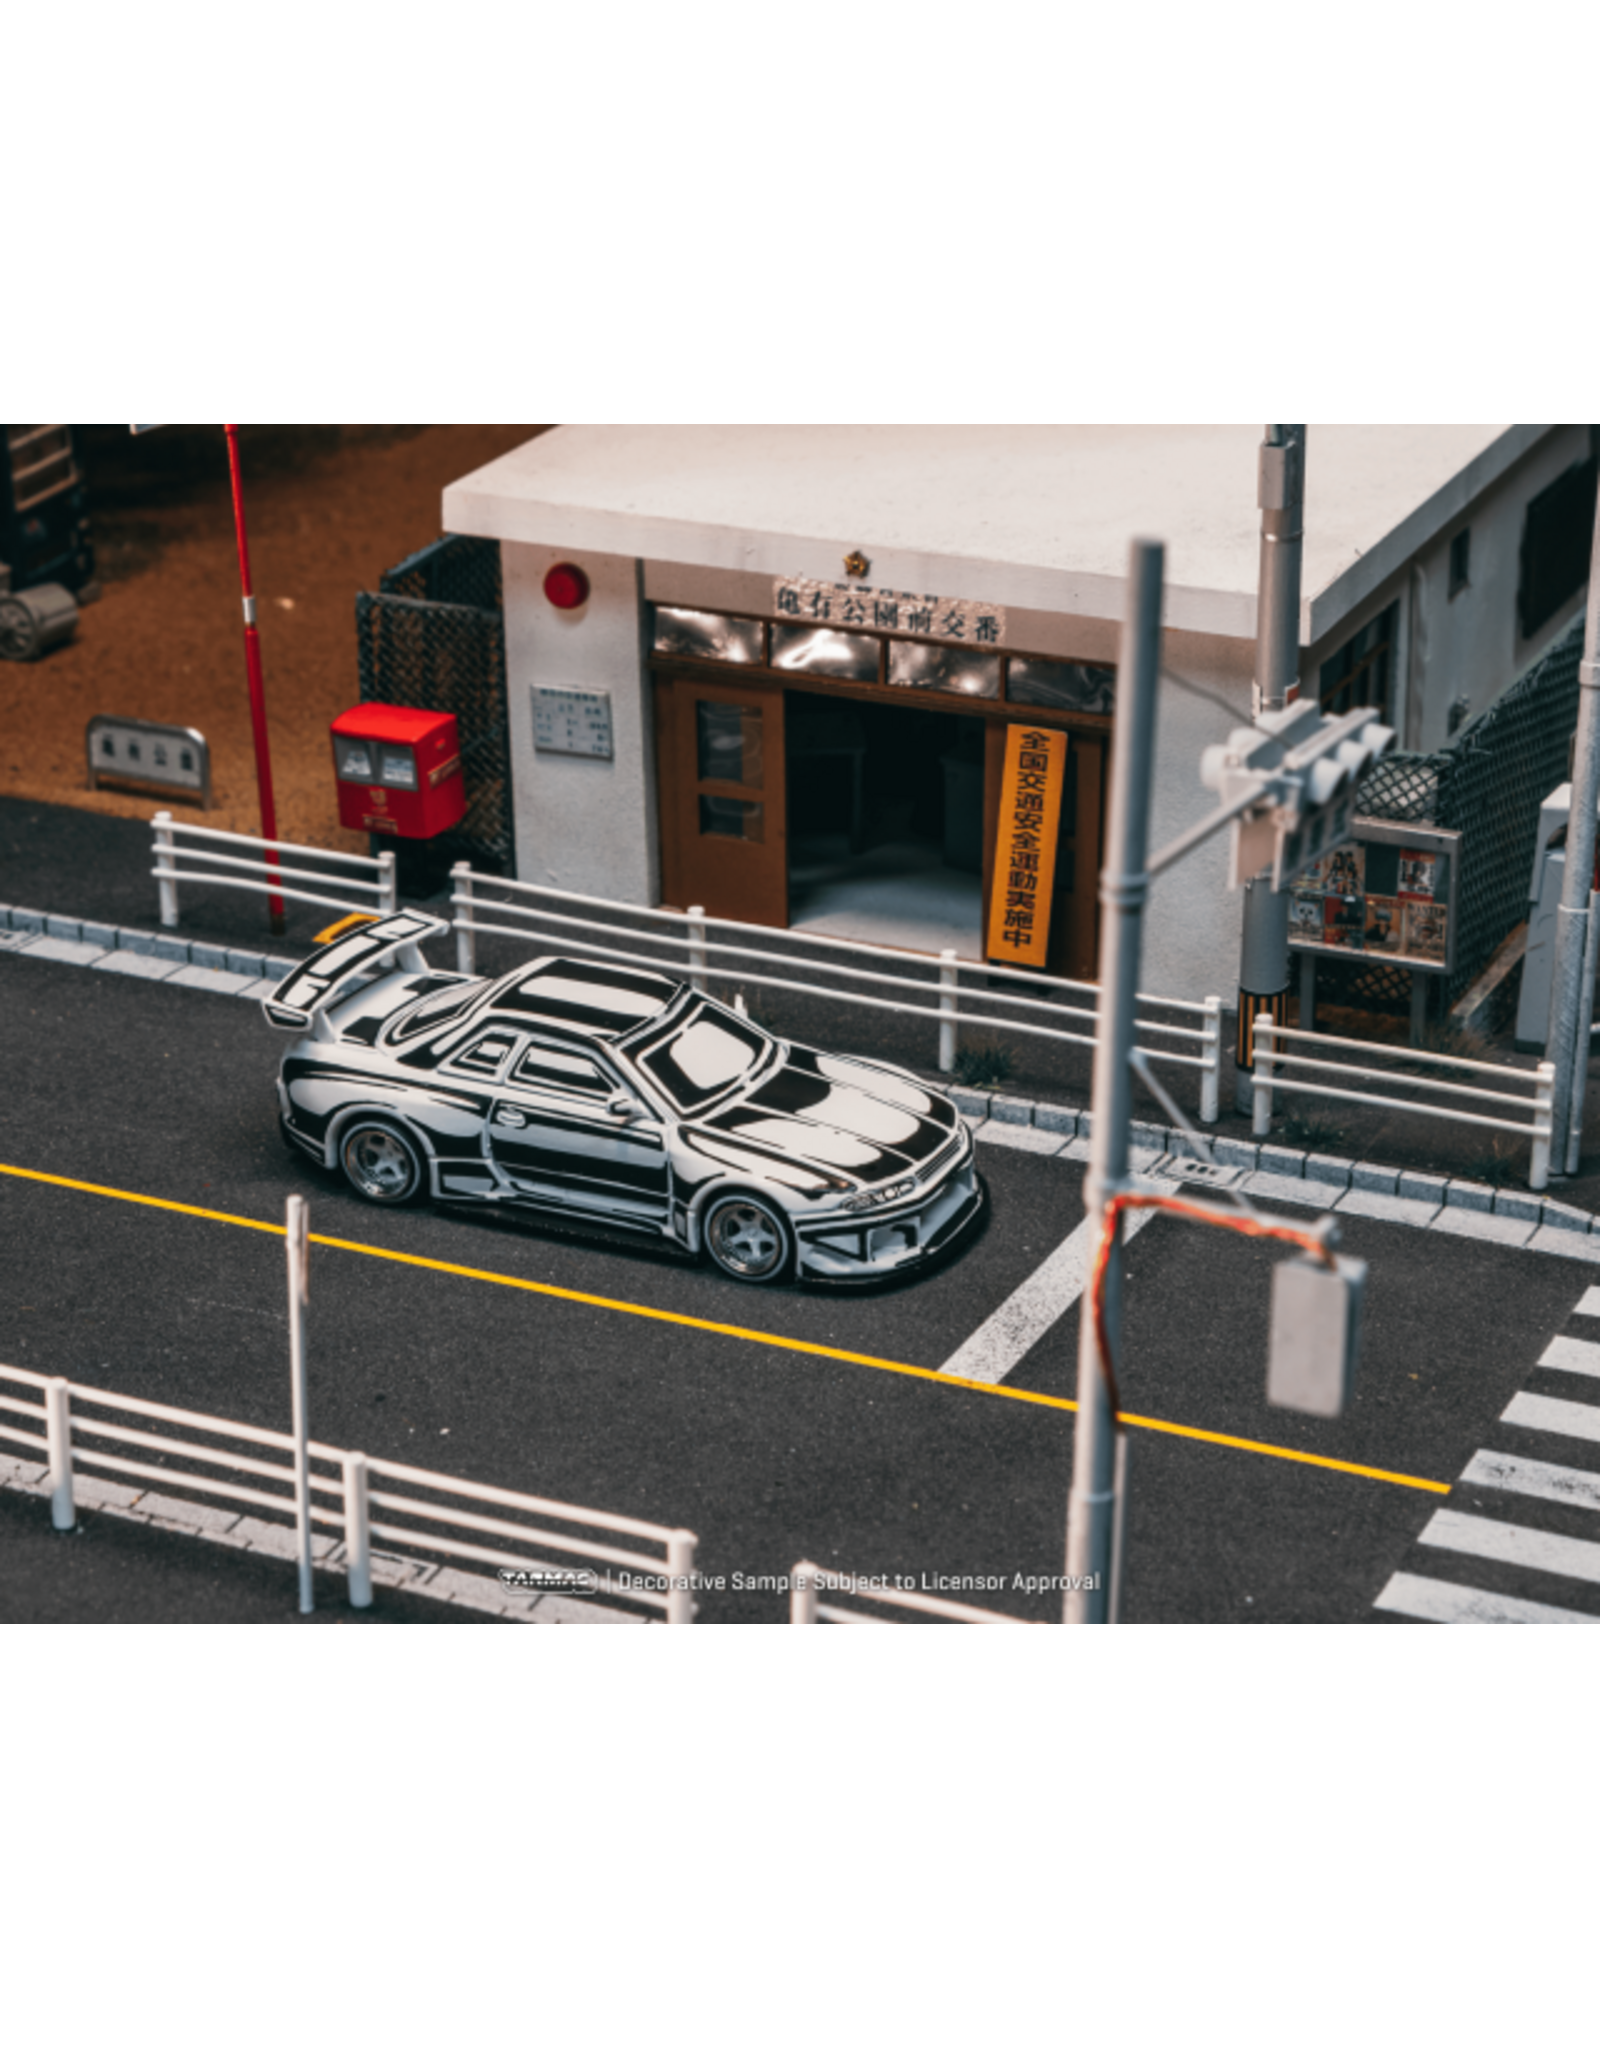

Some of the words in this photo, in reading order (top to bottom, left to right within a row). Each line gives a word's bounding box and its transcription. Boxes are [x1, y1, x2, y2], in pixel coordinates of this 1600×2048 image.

[1002, 730, 1051, 949] 全国交通安全運動実施中
